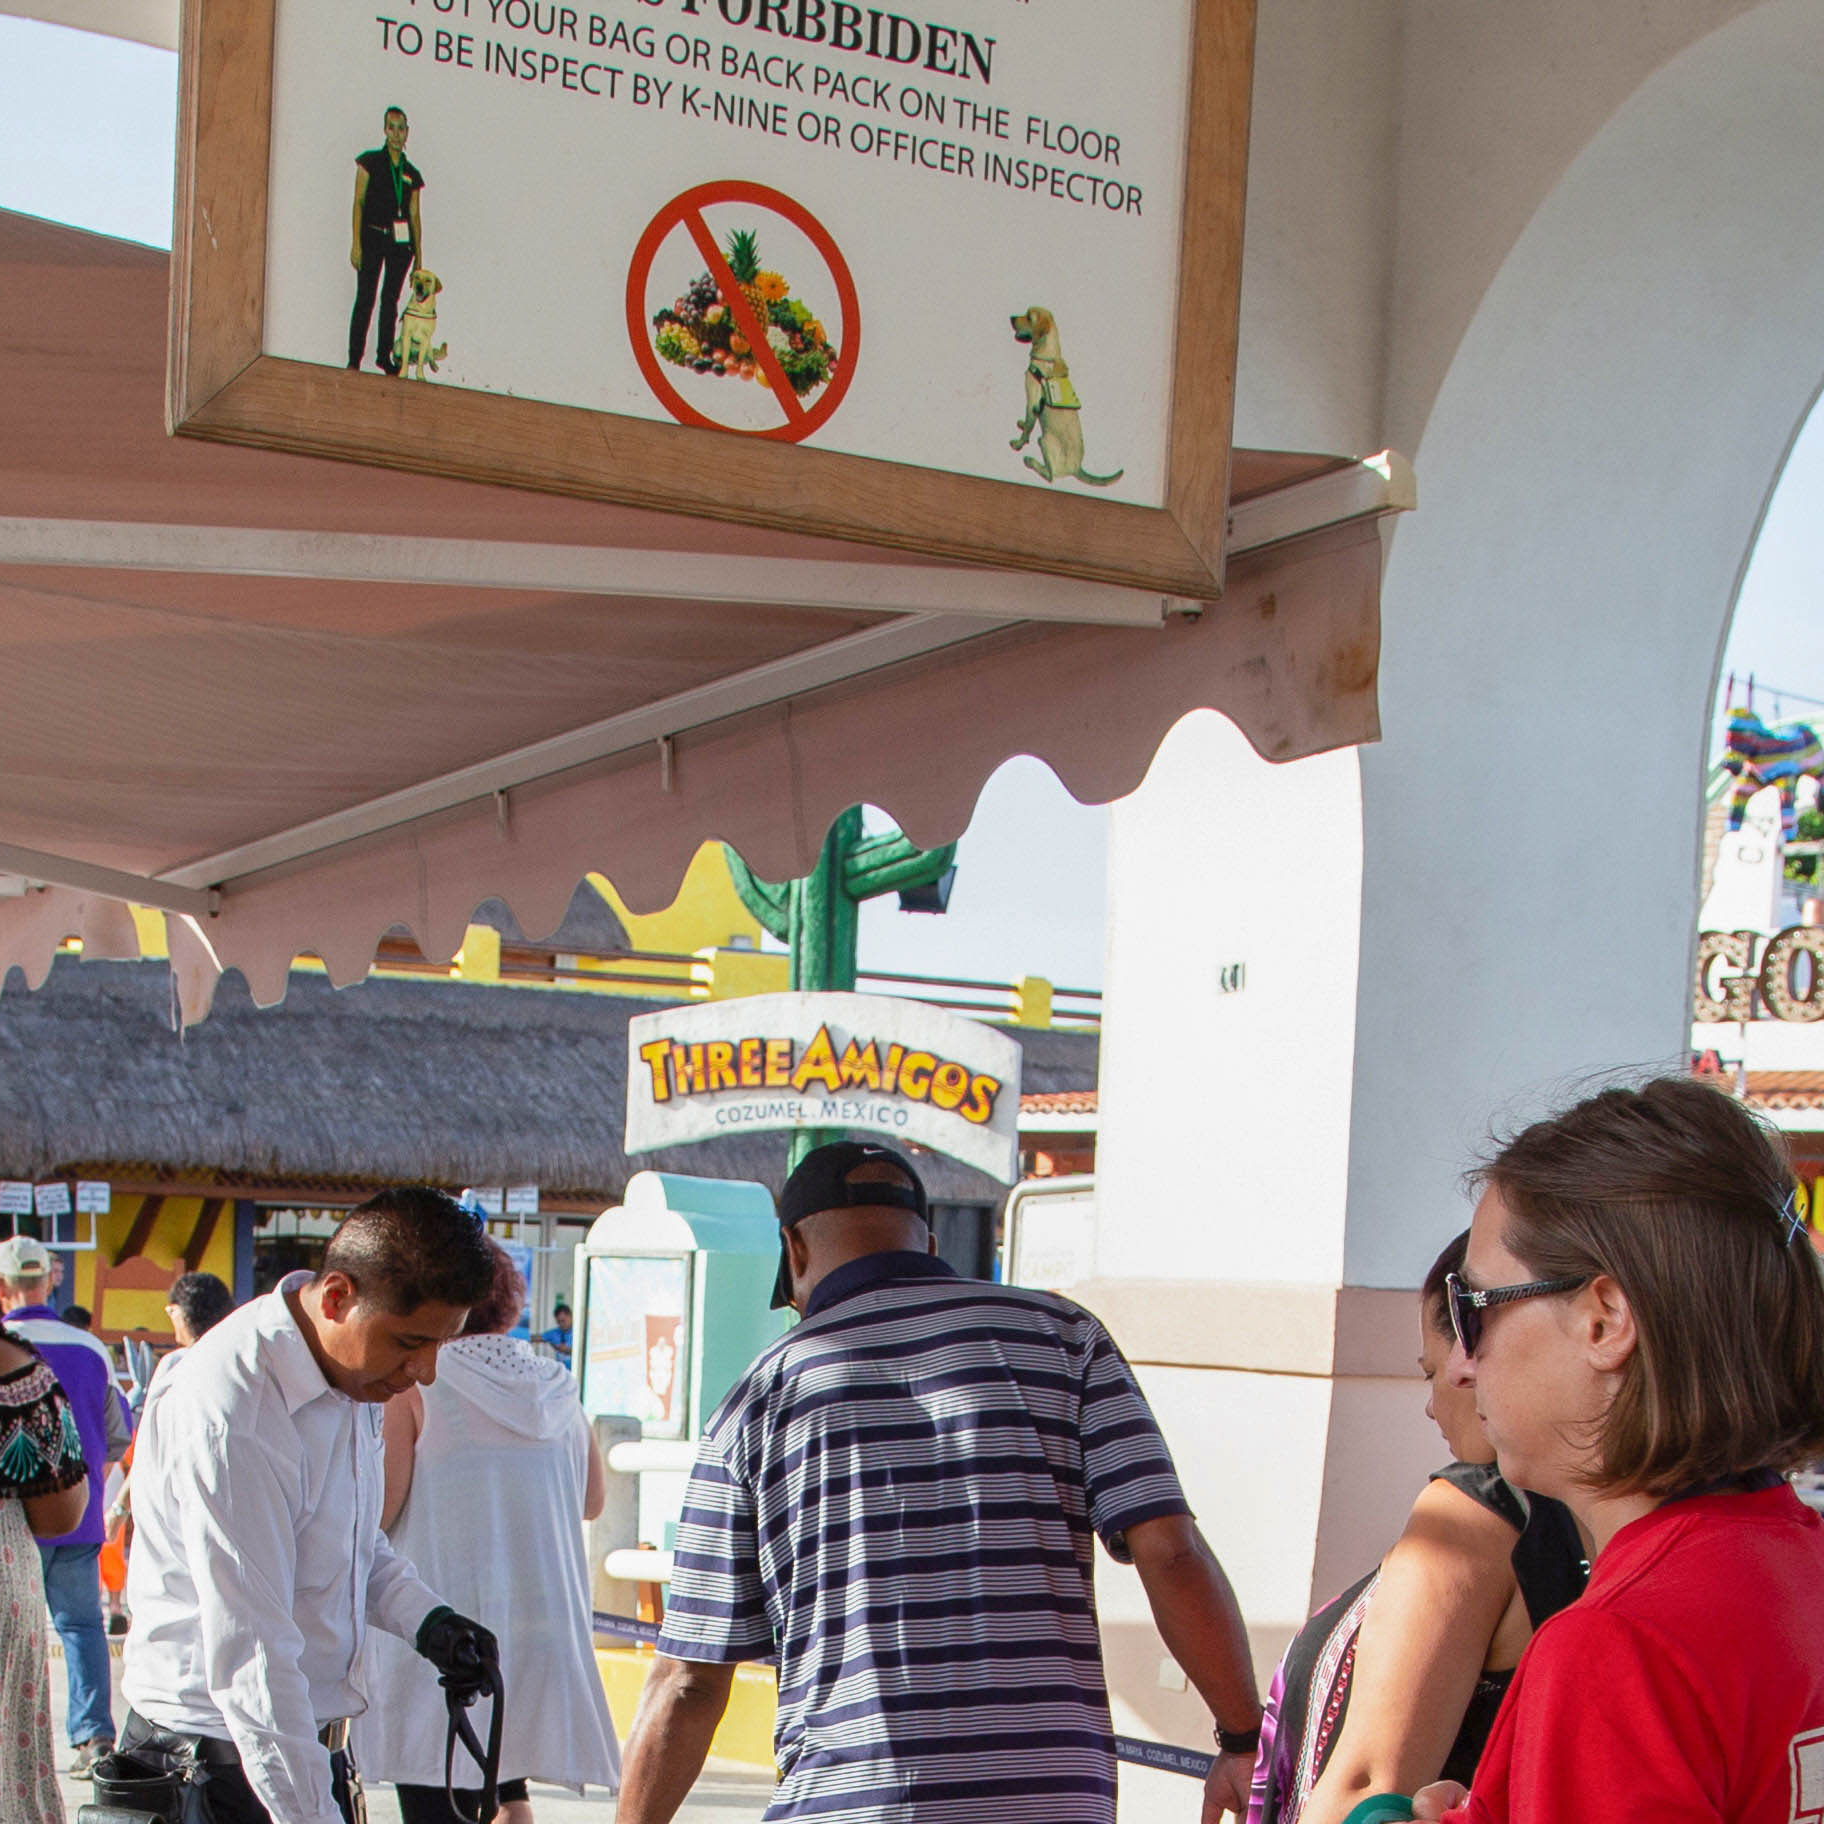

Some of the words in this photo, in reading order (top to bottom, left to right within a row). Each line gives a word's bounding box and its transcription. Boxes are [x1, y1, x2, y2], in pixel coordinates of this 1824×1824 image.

[376, 17, 423, 56] TO
[435, 30, 474, 68] BE
[485, 40, 623, 99] INSPECT
[632, 74, 672, 109] BY
[682, 84, 788, 137] K-NINE
[797, 111, 841, 148] OR
[850, 122, 975, 178] OFFICER
[984, 152, 1143, 216] INSPECTOR
[488, 0, 577, 41] YOUR
[589, 14, 655, 58] BAG
[665, 33, 710, 72] OR
[721, 45, 804, 92] BACK
[814, 66, 890, 112] PACK
[900, 87, 945, 125] ON
[953, 98, 1009, 140] THE
[1026, 116, 1121, 166] FLOOR
[639, 1037, 794, 1103] THREE
[790, 1022, 1003, 1126] AMIGOS
[820, 1101, 909, 1127] MEXICO
